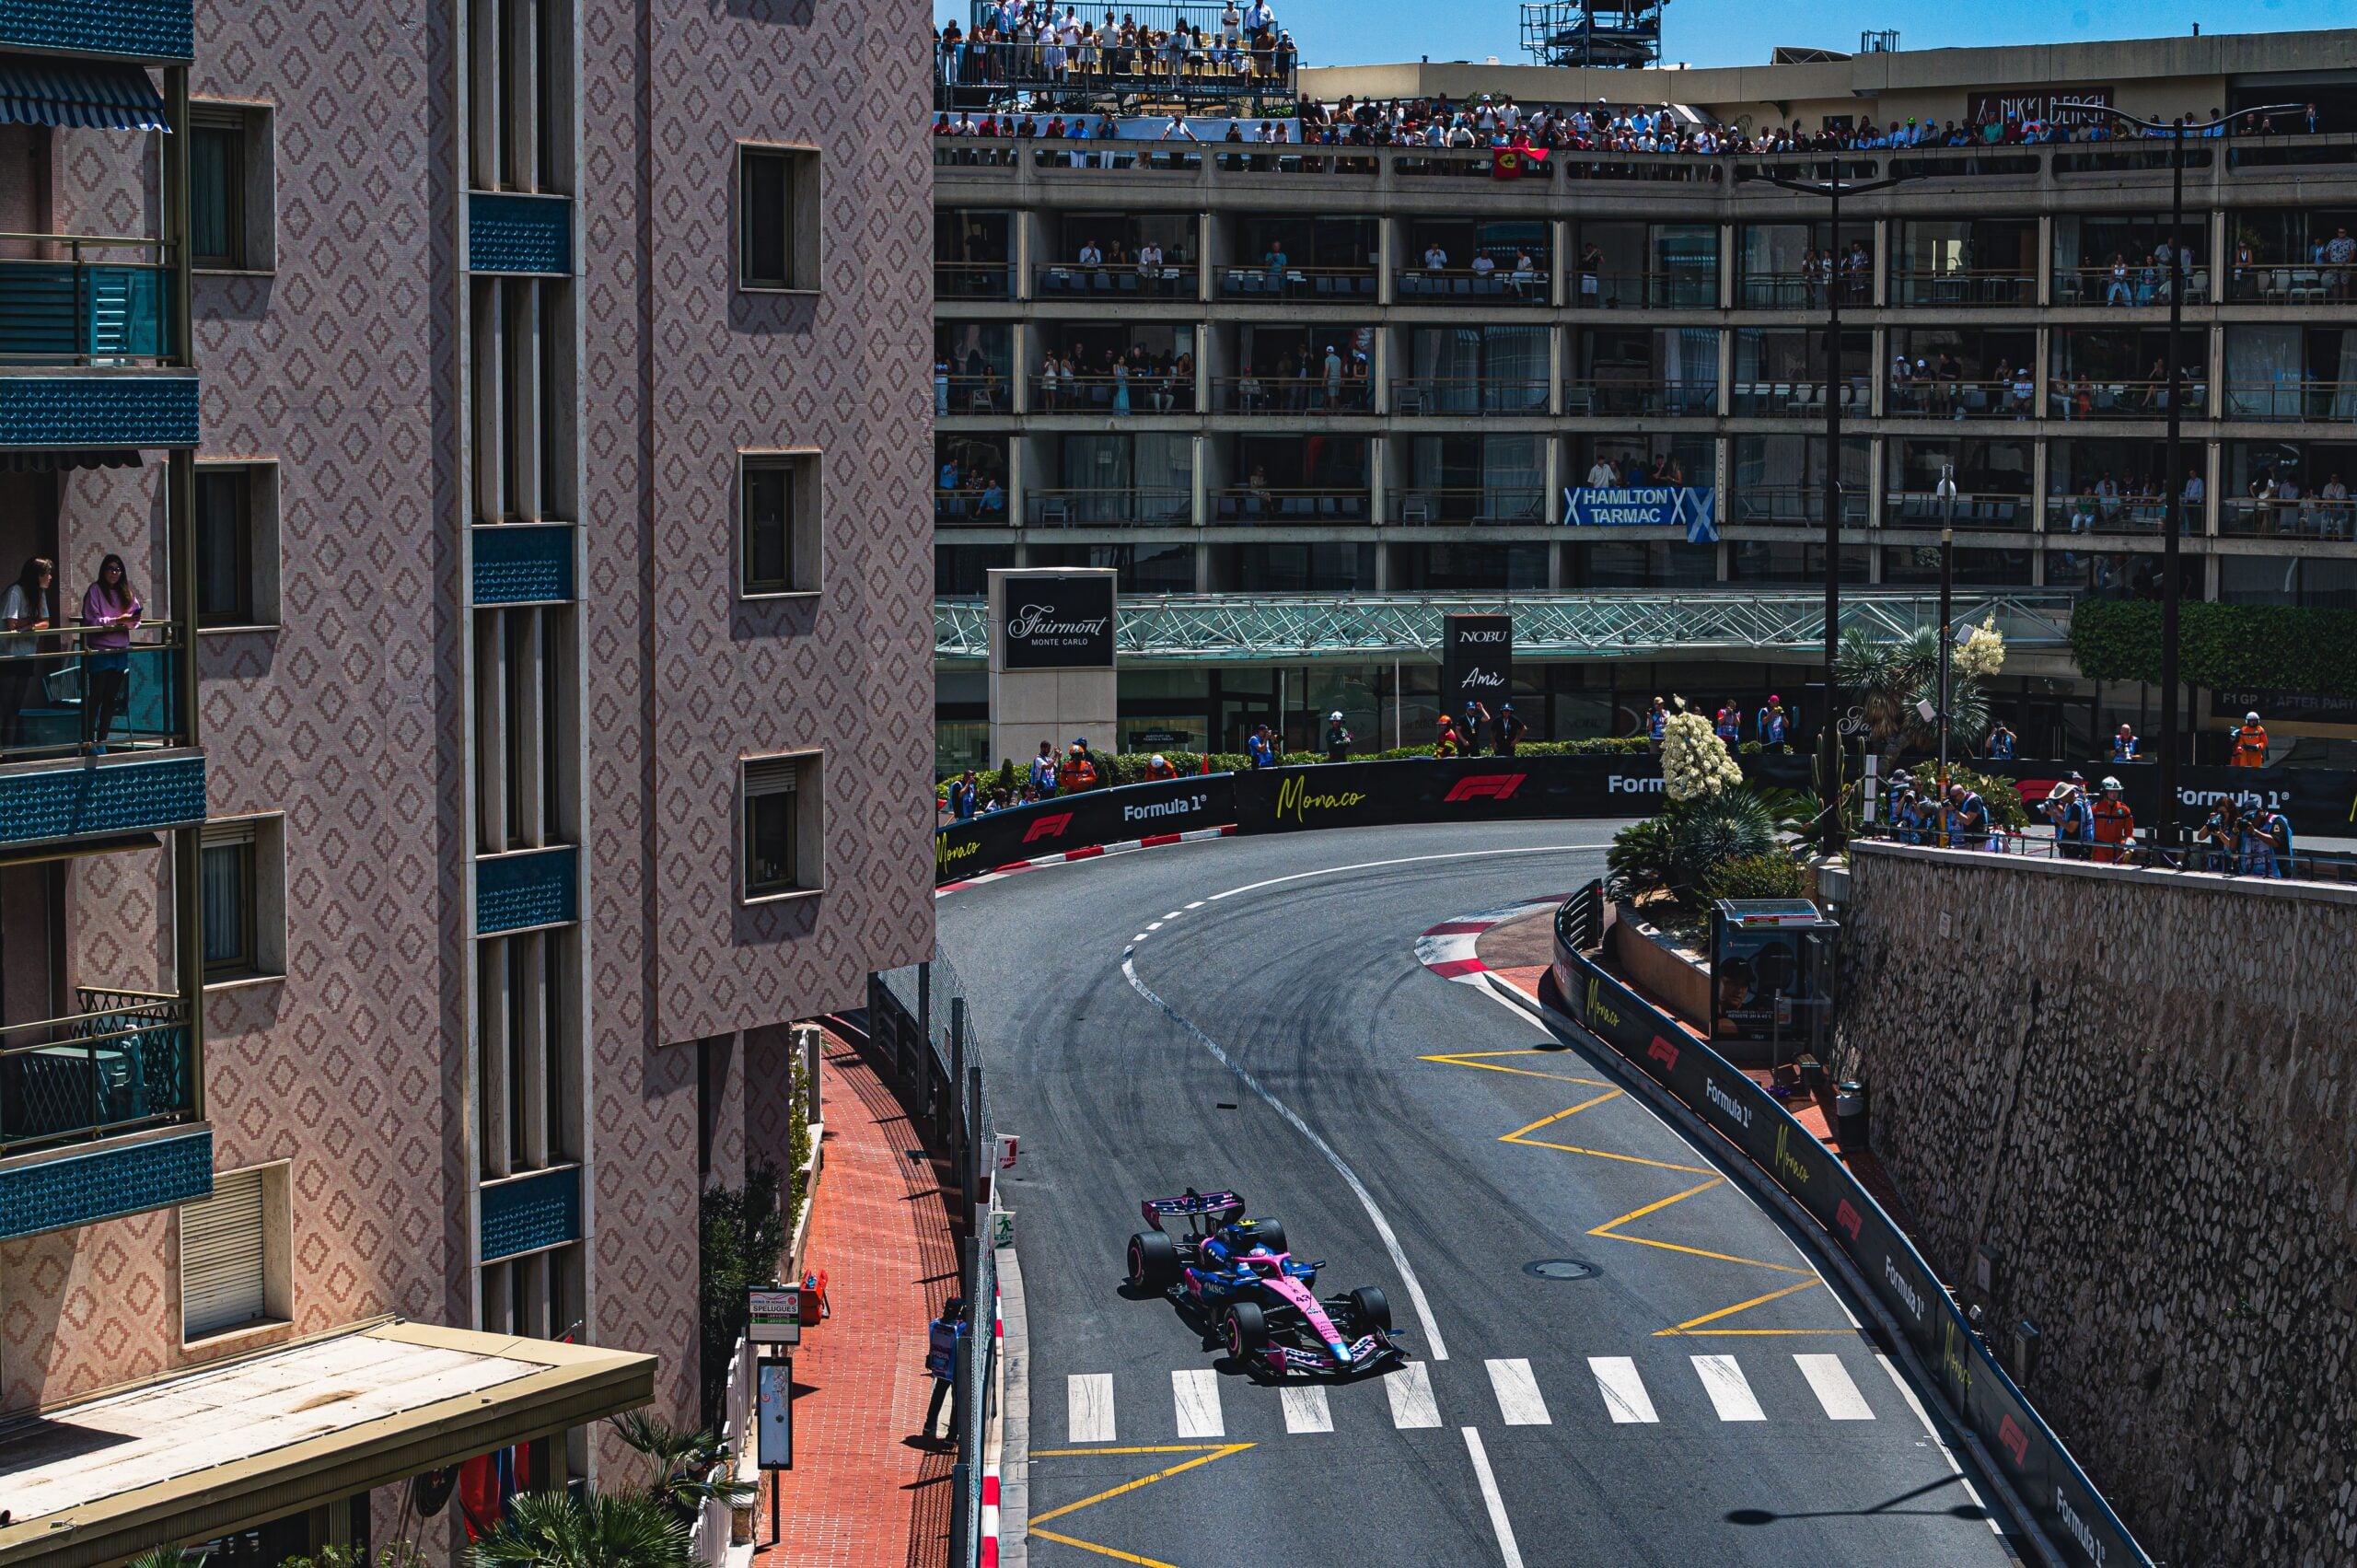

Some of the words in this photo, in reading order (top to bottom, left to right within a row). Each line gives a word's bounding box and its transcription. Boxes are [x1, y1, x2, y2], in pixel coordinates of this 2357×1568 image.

[2049, 95, 2105, 124] BEACH
[1584, 489, 1667, 505] HAMILTON
[1589, 507, 1661, 524] TARMAC
[1008, 604, 1109, 639] Fairmont
[1459, 631, 1508, 643] NOBU
[2223, 693, 2236, 704] F1
[2240, 693, 2258, 705] GP
[2276, 696, 2318, 708] AFTER
[1123, 797, 1188, 822] Formula
[1277, 774, 1366, 823] Monaco
[935, 831, 981, 875] Monaco
[1586, 977, 1620, 1028] Monaco
[1706, 1076, 1742, 1122] Formula
[1775, 1122, 1810, 1184] Monaco
[1208, 1283, 1225, 1295] MSC
[1885, 1254, 1916, 1314] Formula
[2056, 1485, 2095, 1562] Formula
